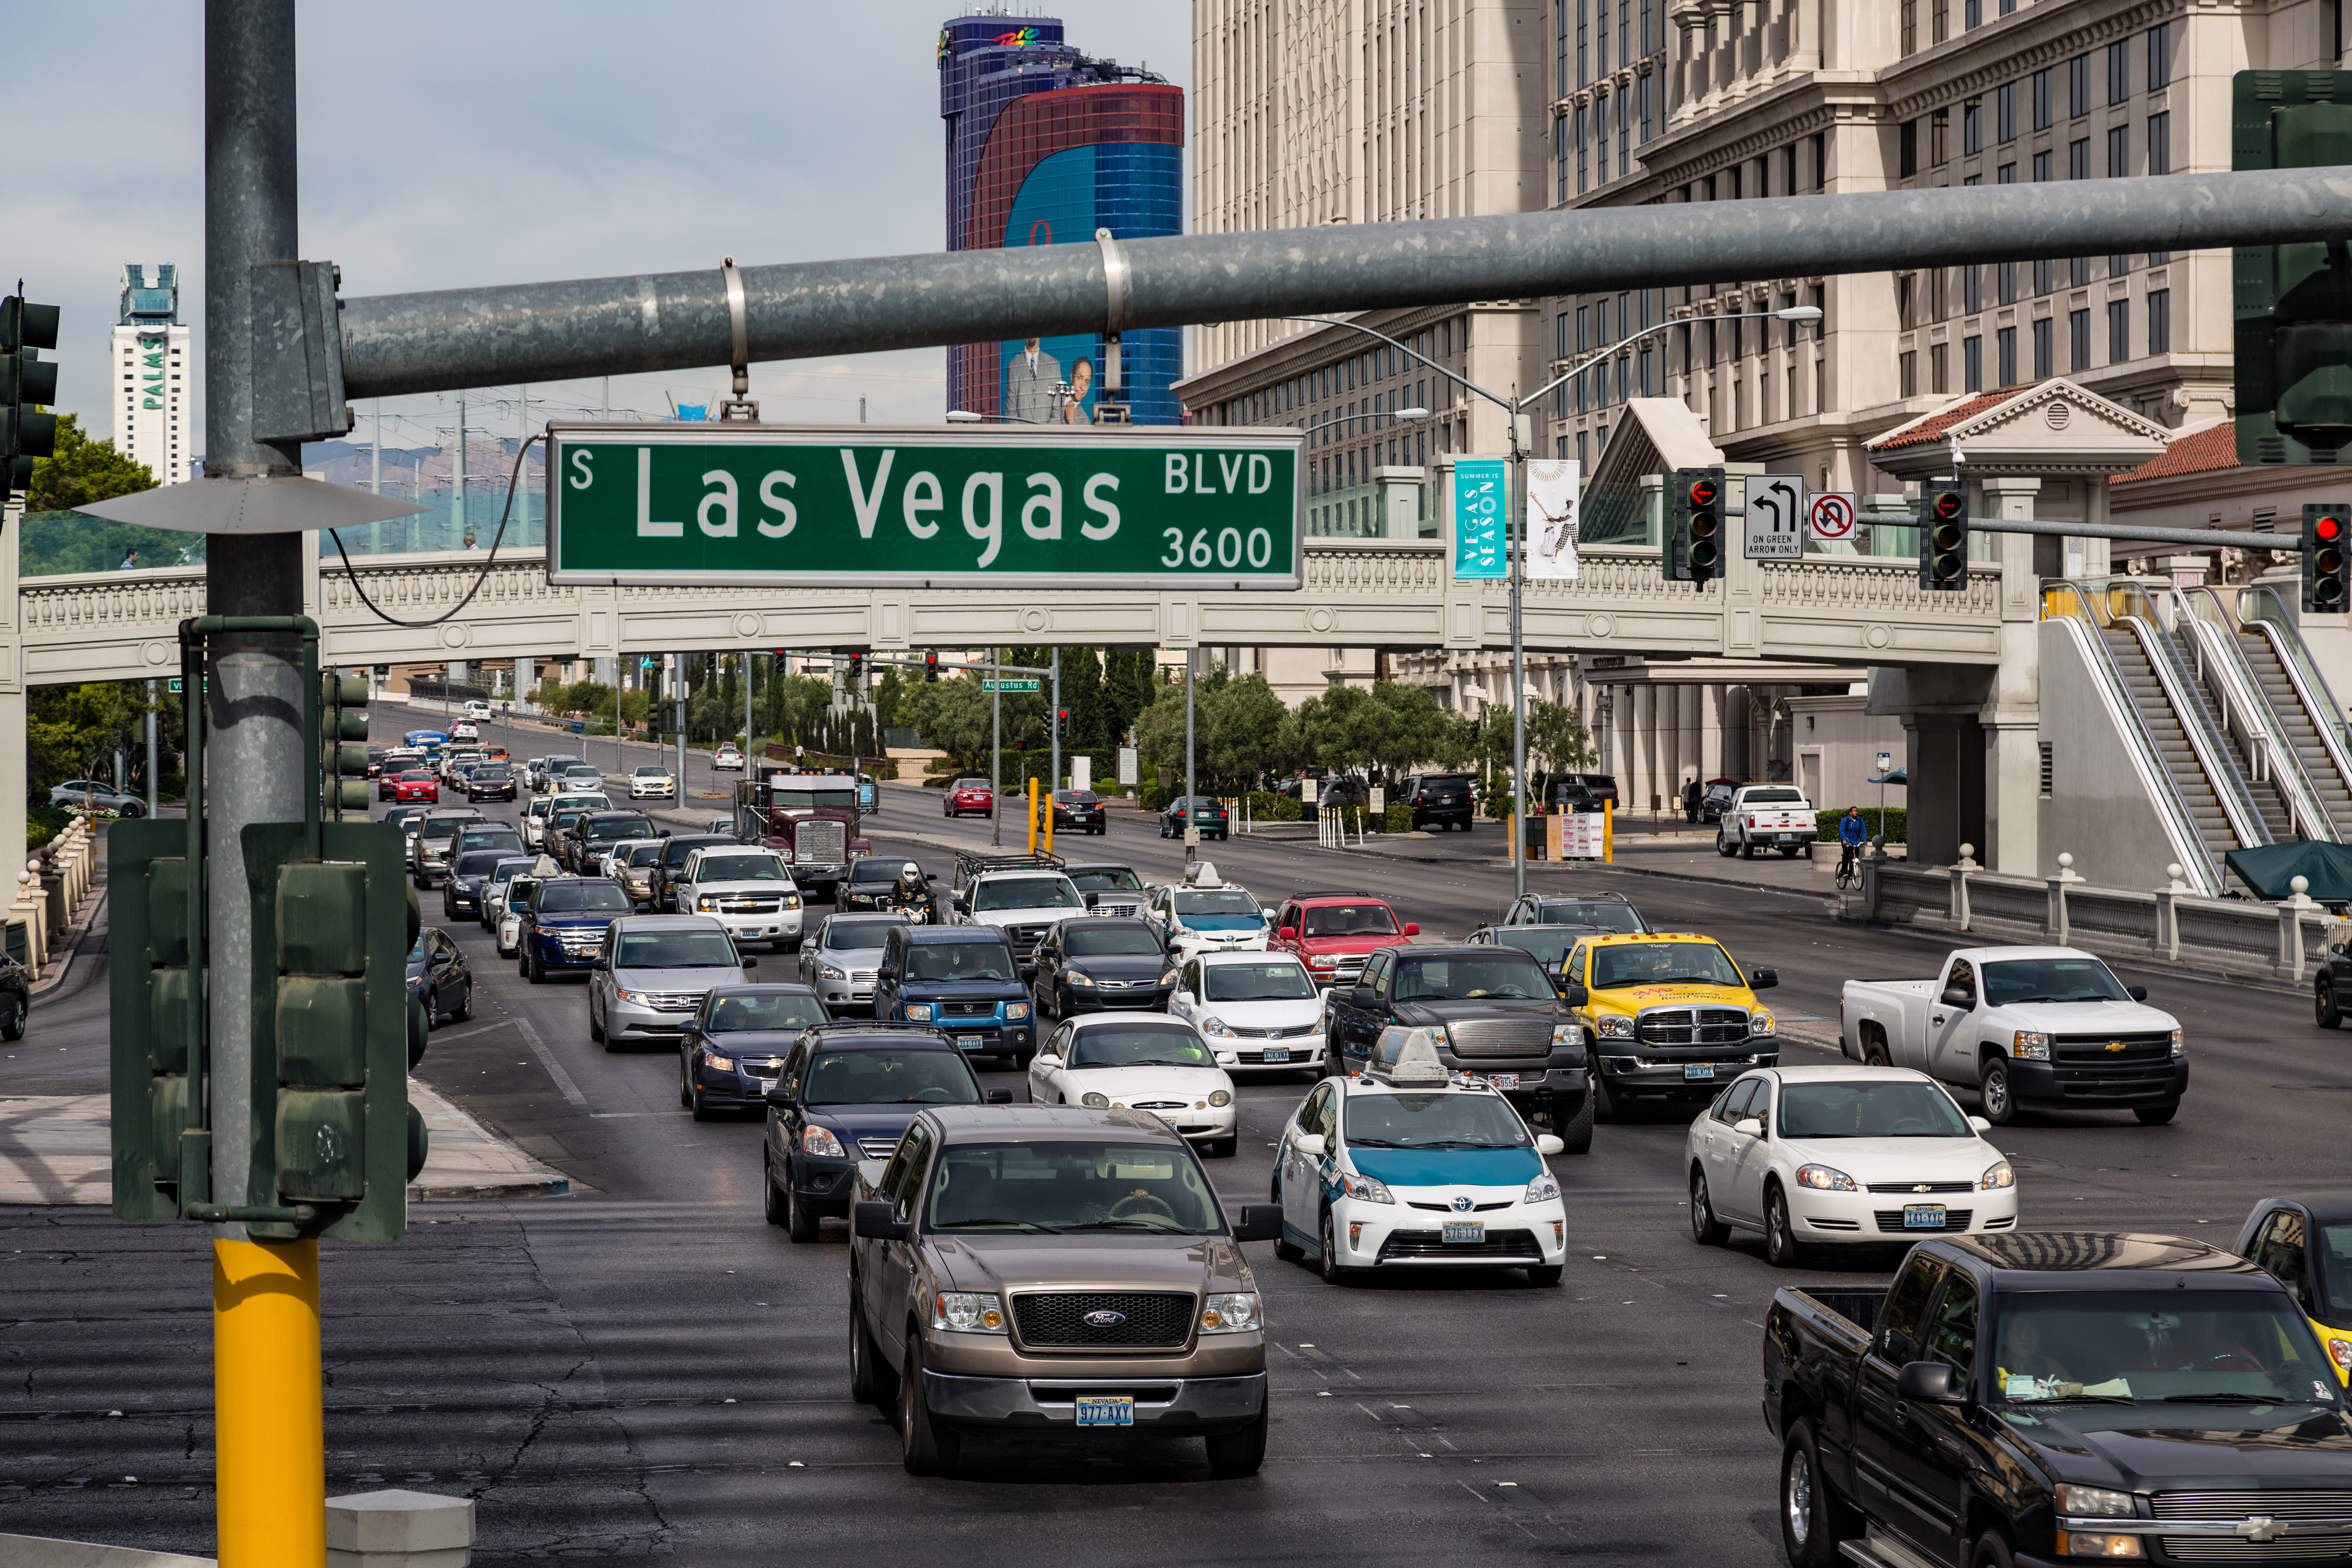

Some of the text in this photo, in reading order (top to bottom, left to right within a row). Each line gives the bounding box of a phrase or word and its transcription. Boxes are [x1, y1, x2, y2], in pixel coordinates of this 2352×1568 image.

[993, 26, 1042, 45] Rio
[143, 338, 164, 410] PALMS
[1165, 453, 1272, 494] BLVD
[570, 448, 1121, 569] S Las Vegas
[1465, 489, 1479, 561] VEGAS
[1479, 482, 1497, 566] SEASON
[1160, 527, 1272, 569] 3600
[1748, 545, 1798, 553] ARROW ONLY
[1328, 1167, 1342, 1188] 540
[1093, 1313, 1116, 1323] Ford
